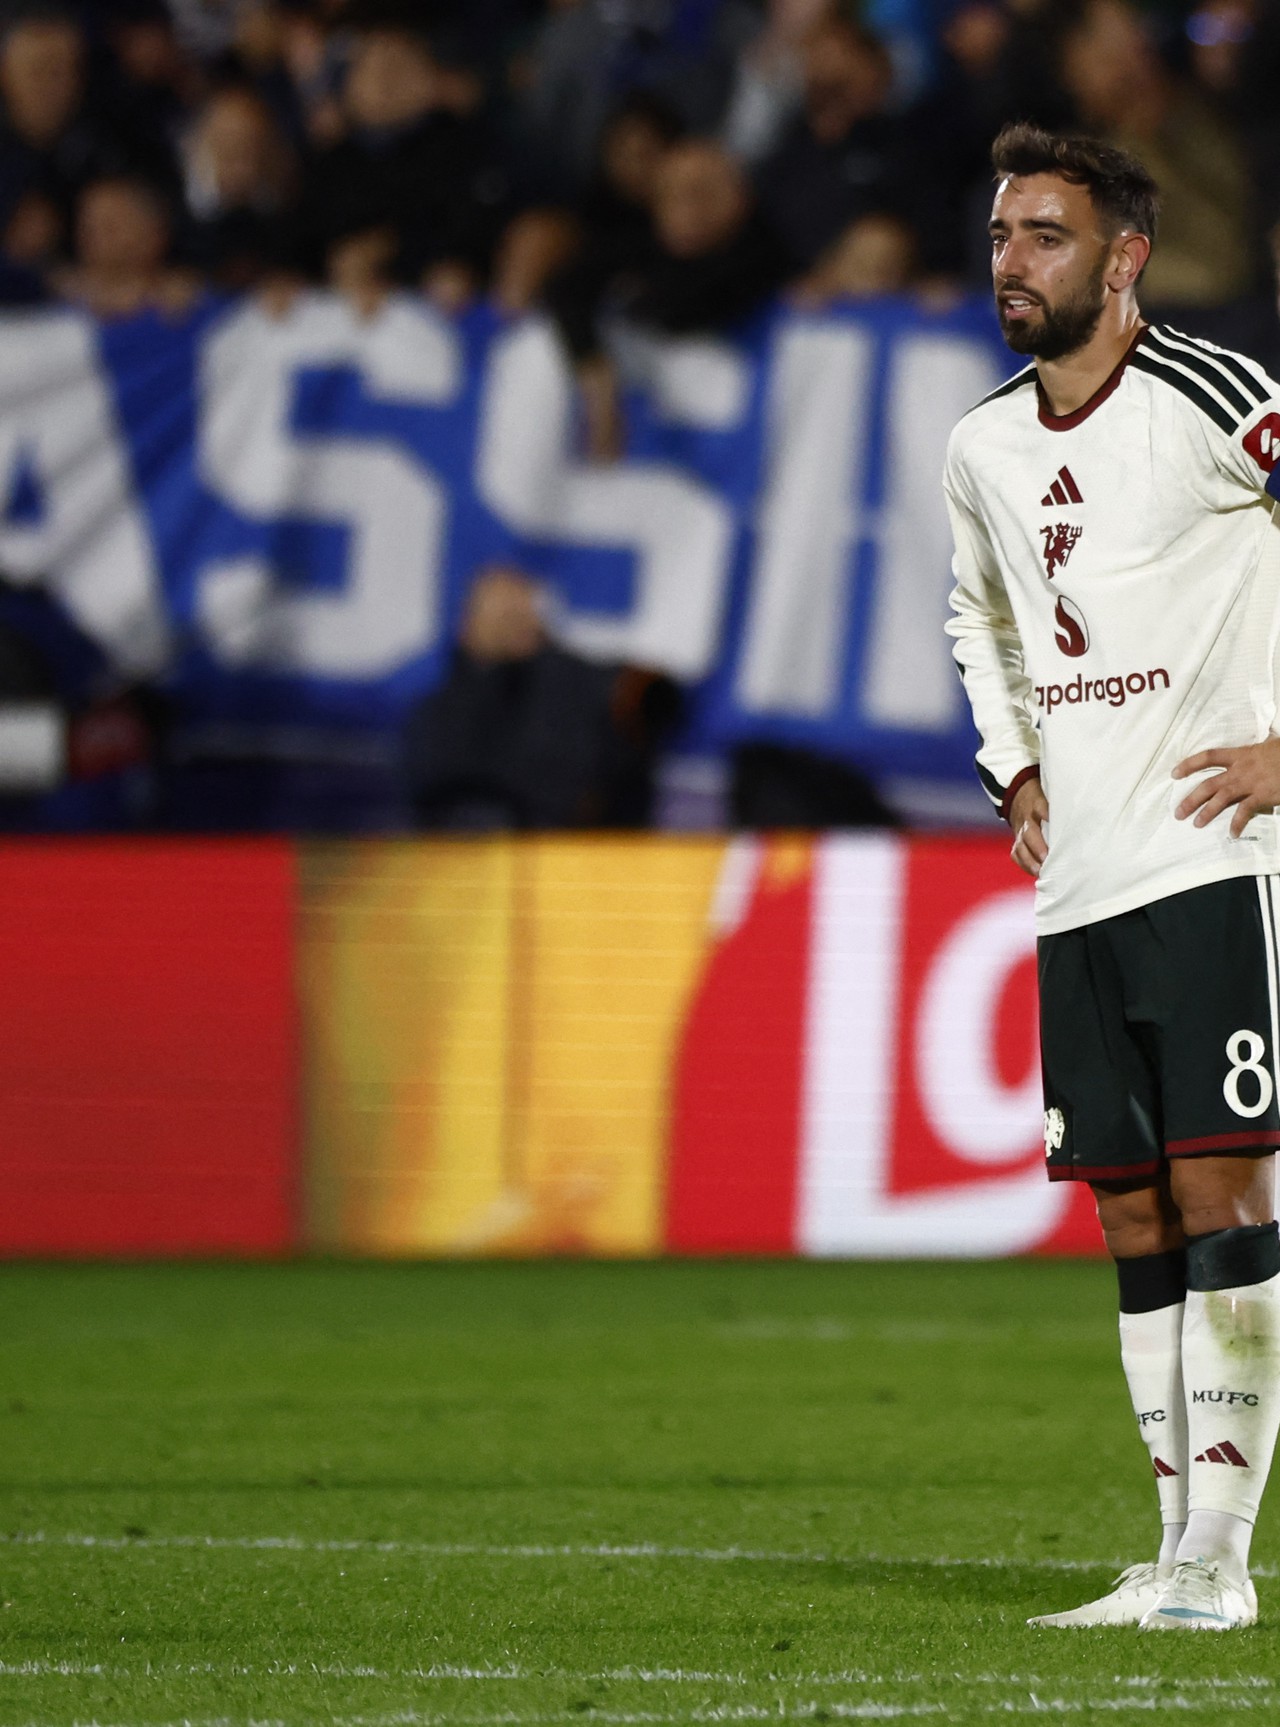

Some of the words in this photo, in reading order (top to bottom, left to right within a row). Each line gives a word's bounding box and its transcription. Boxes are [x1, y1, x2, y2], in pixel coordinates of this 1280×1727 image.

[1223, 1029, 1273, 1119] 8
[1193, 1390, 1259, 1407] MUFC
[1137, 1409, 1166, 1427] FC
